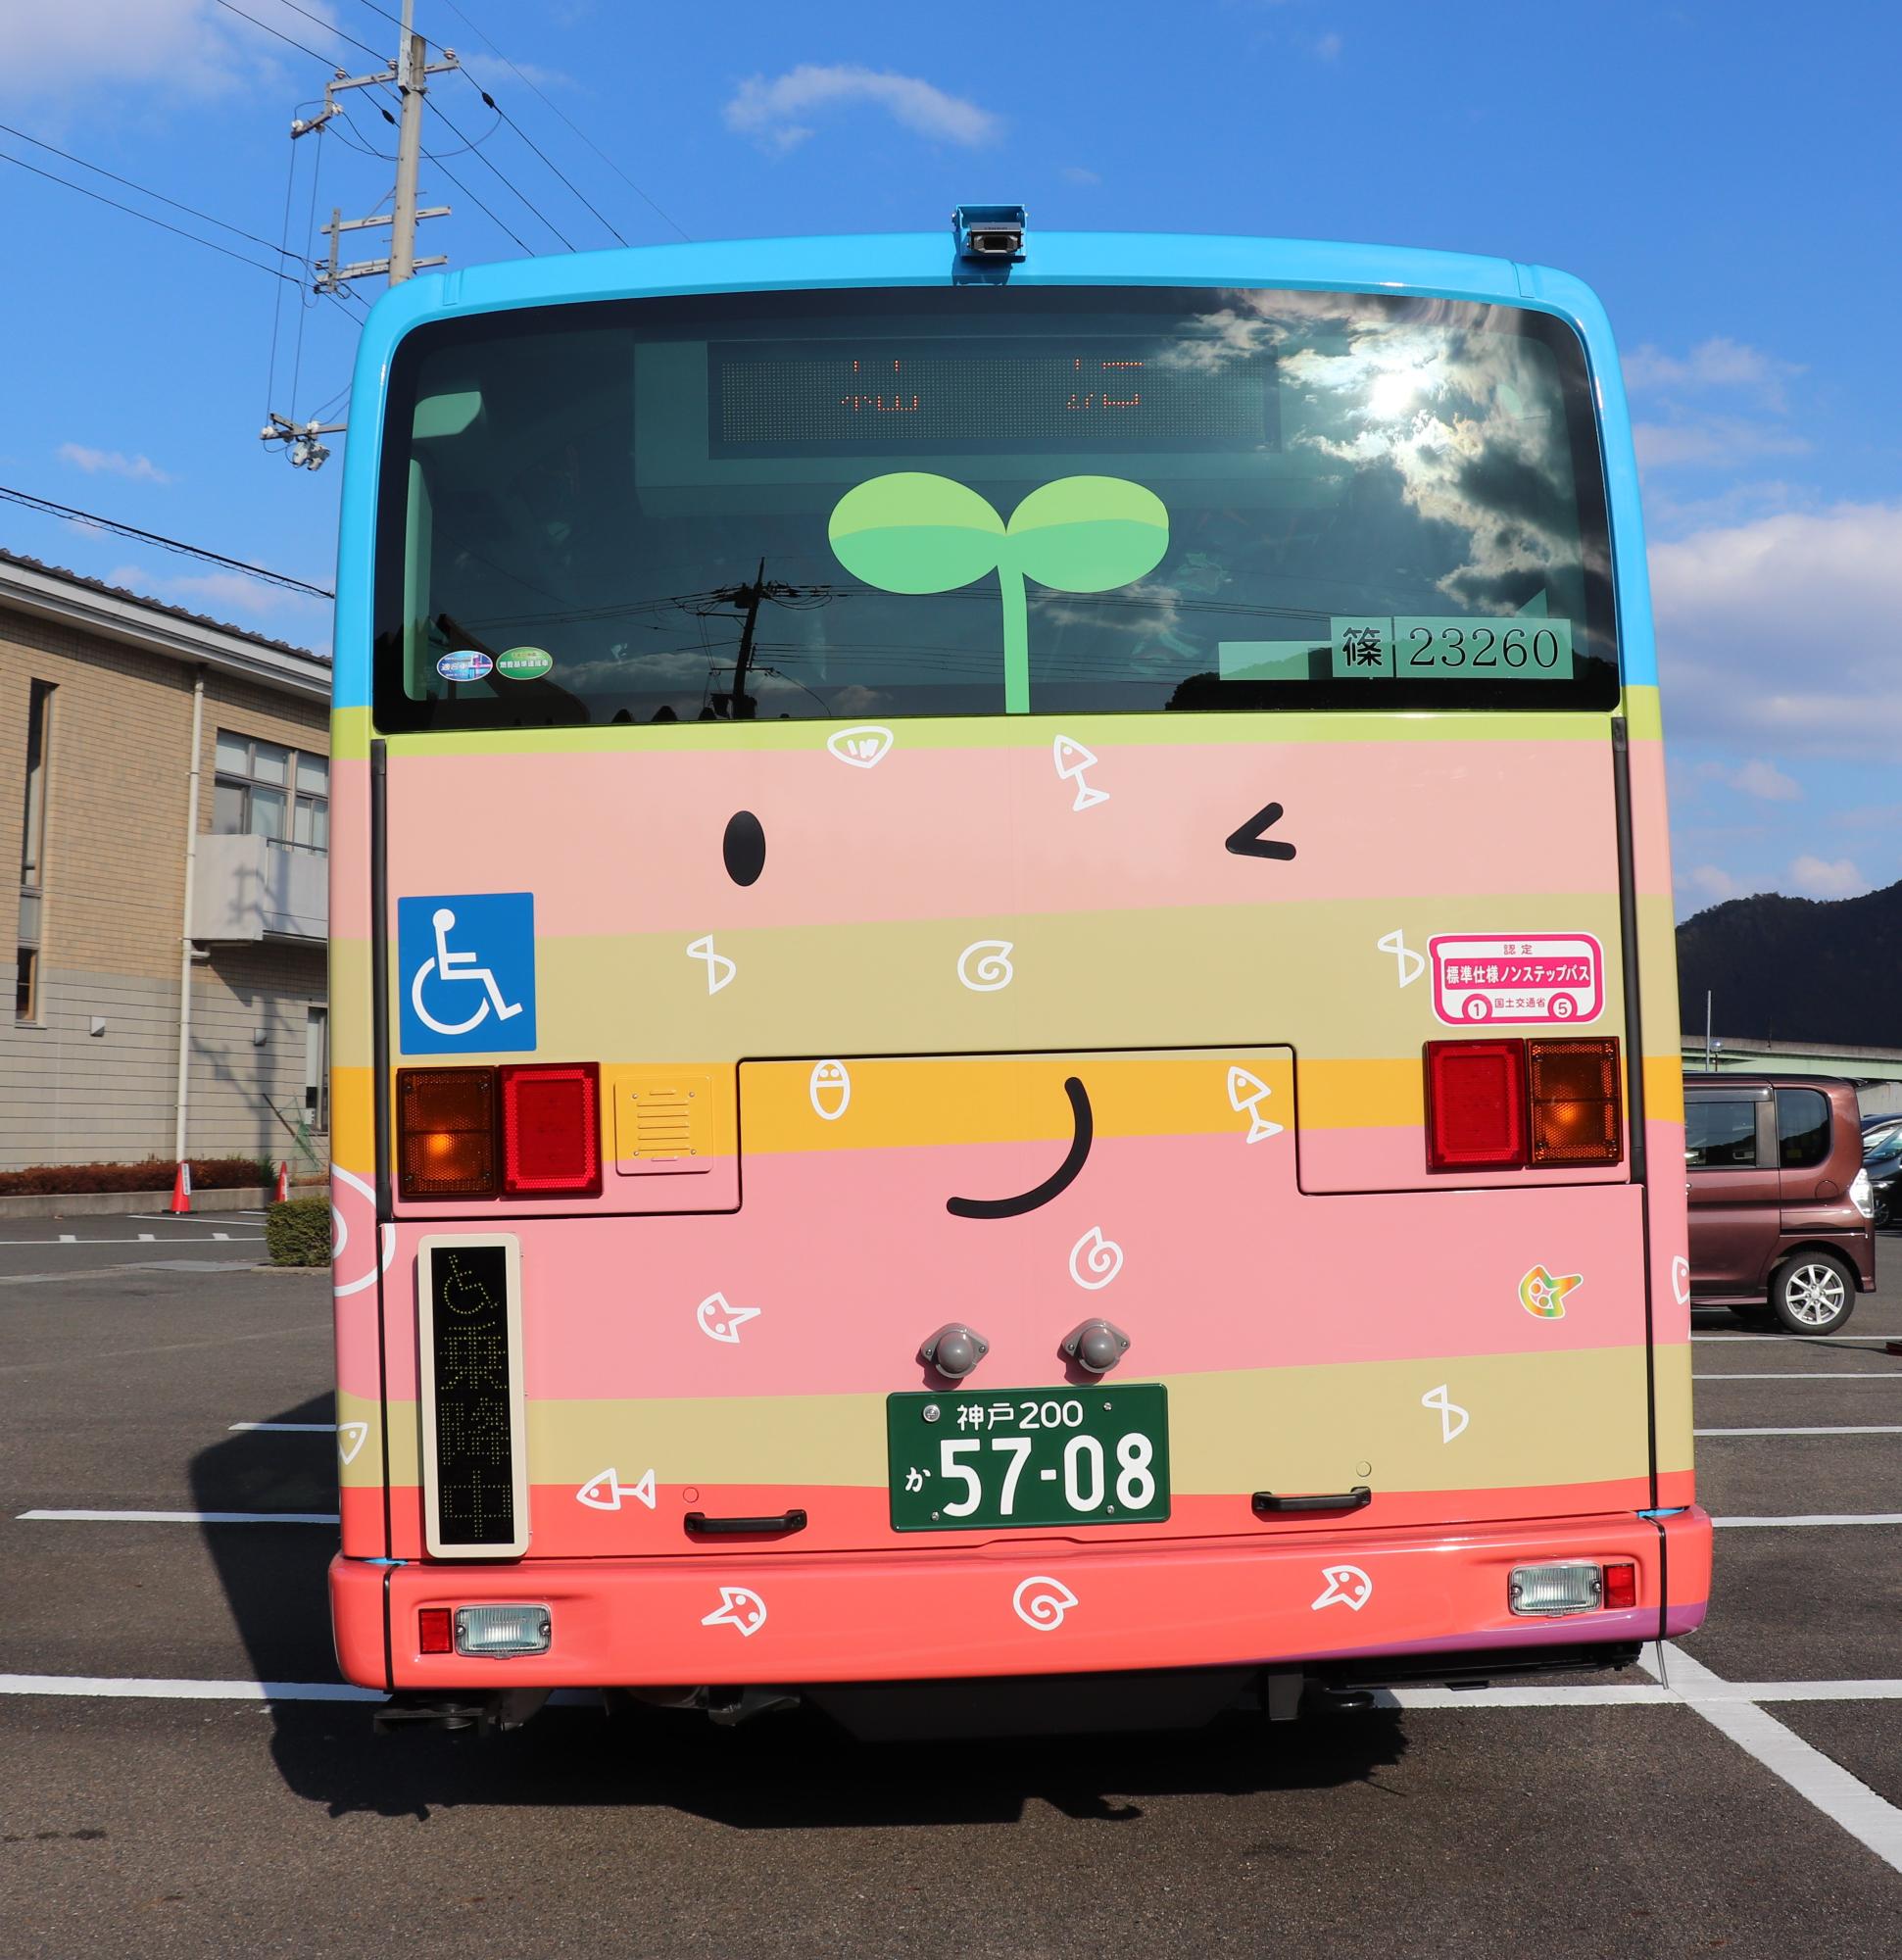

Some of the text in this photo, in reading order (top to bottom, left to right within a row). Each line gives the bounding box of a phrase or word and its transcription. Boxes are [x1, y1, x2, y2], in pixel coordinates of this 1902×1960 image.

[1342, 627, 1559, 667] 篠 23260
[1446, 964, 1590, 984] 標準仕様ノンステップバス
[1494, 998, 1545, 1008] 国土交通省
[904, 1432, 1156, 1517] か 57-08
